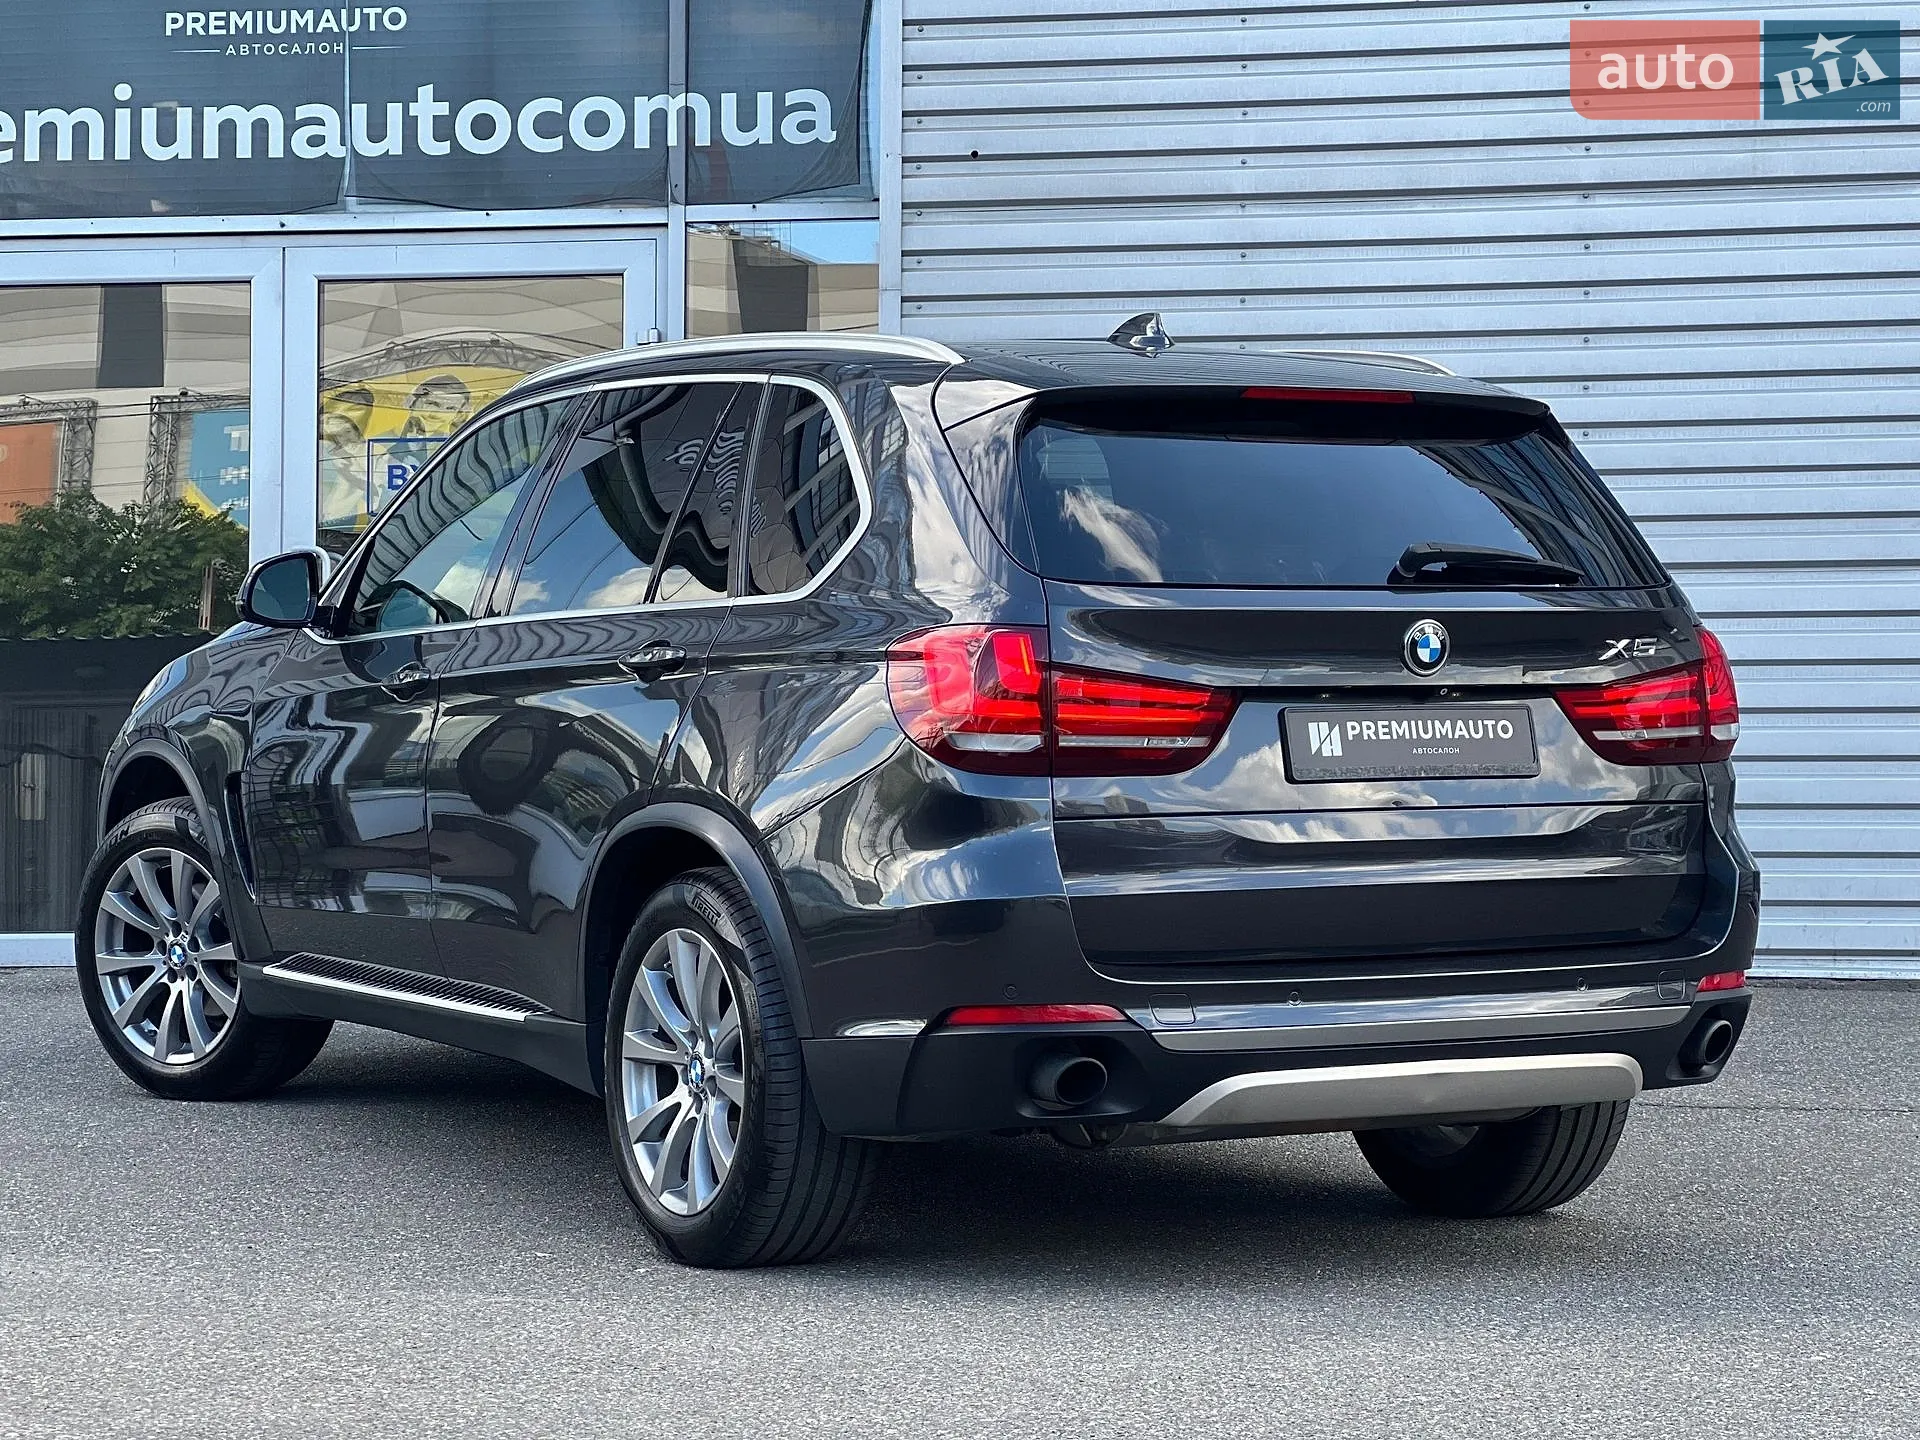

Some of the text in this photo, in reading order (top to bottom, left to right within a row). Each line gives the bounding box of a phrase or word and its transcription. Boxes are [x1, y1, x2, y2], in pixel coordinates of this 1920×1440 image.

[165, 6, 408, 37] PREMIUMAUTO
[225, 42, 344, 56] АВТОСАЛОН
[1598, 637, 1658, 661] X5
[1346, 719, 1514, 742] PREMIUMAUTO
[1412, 746, 1461, 755] АВТОСАЛОН
